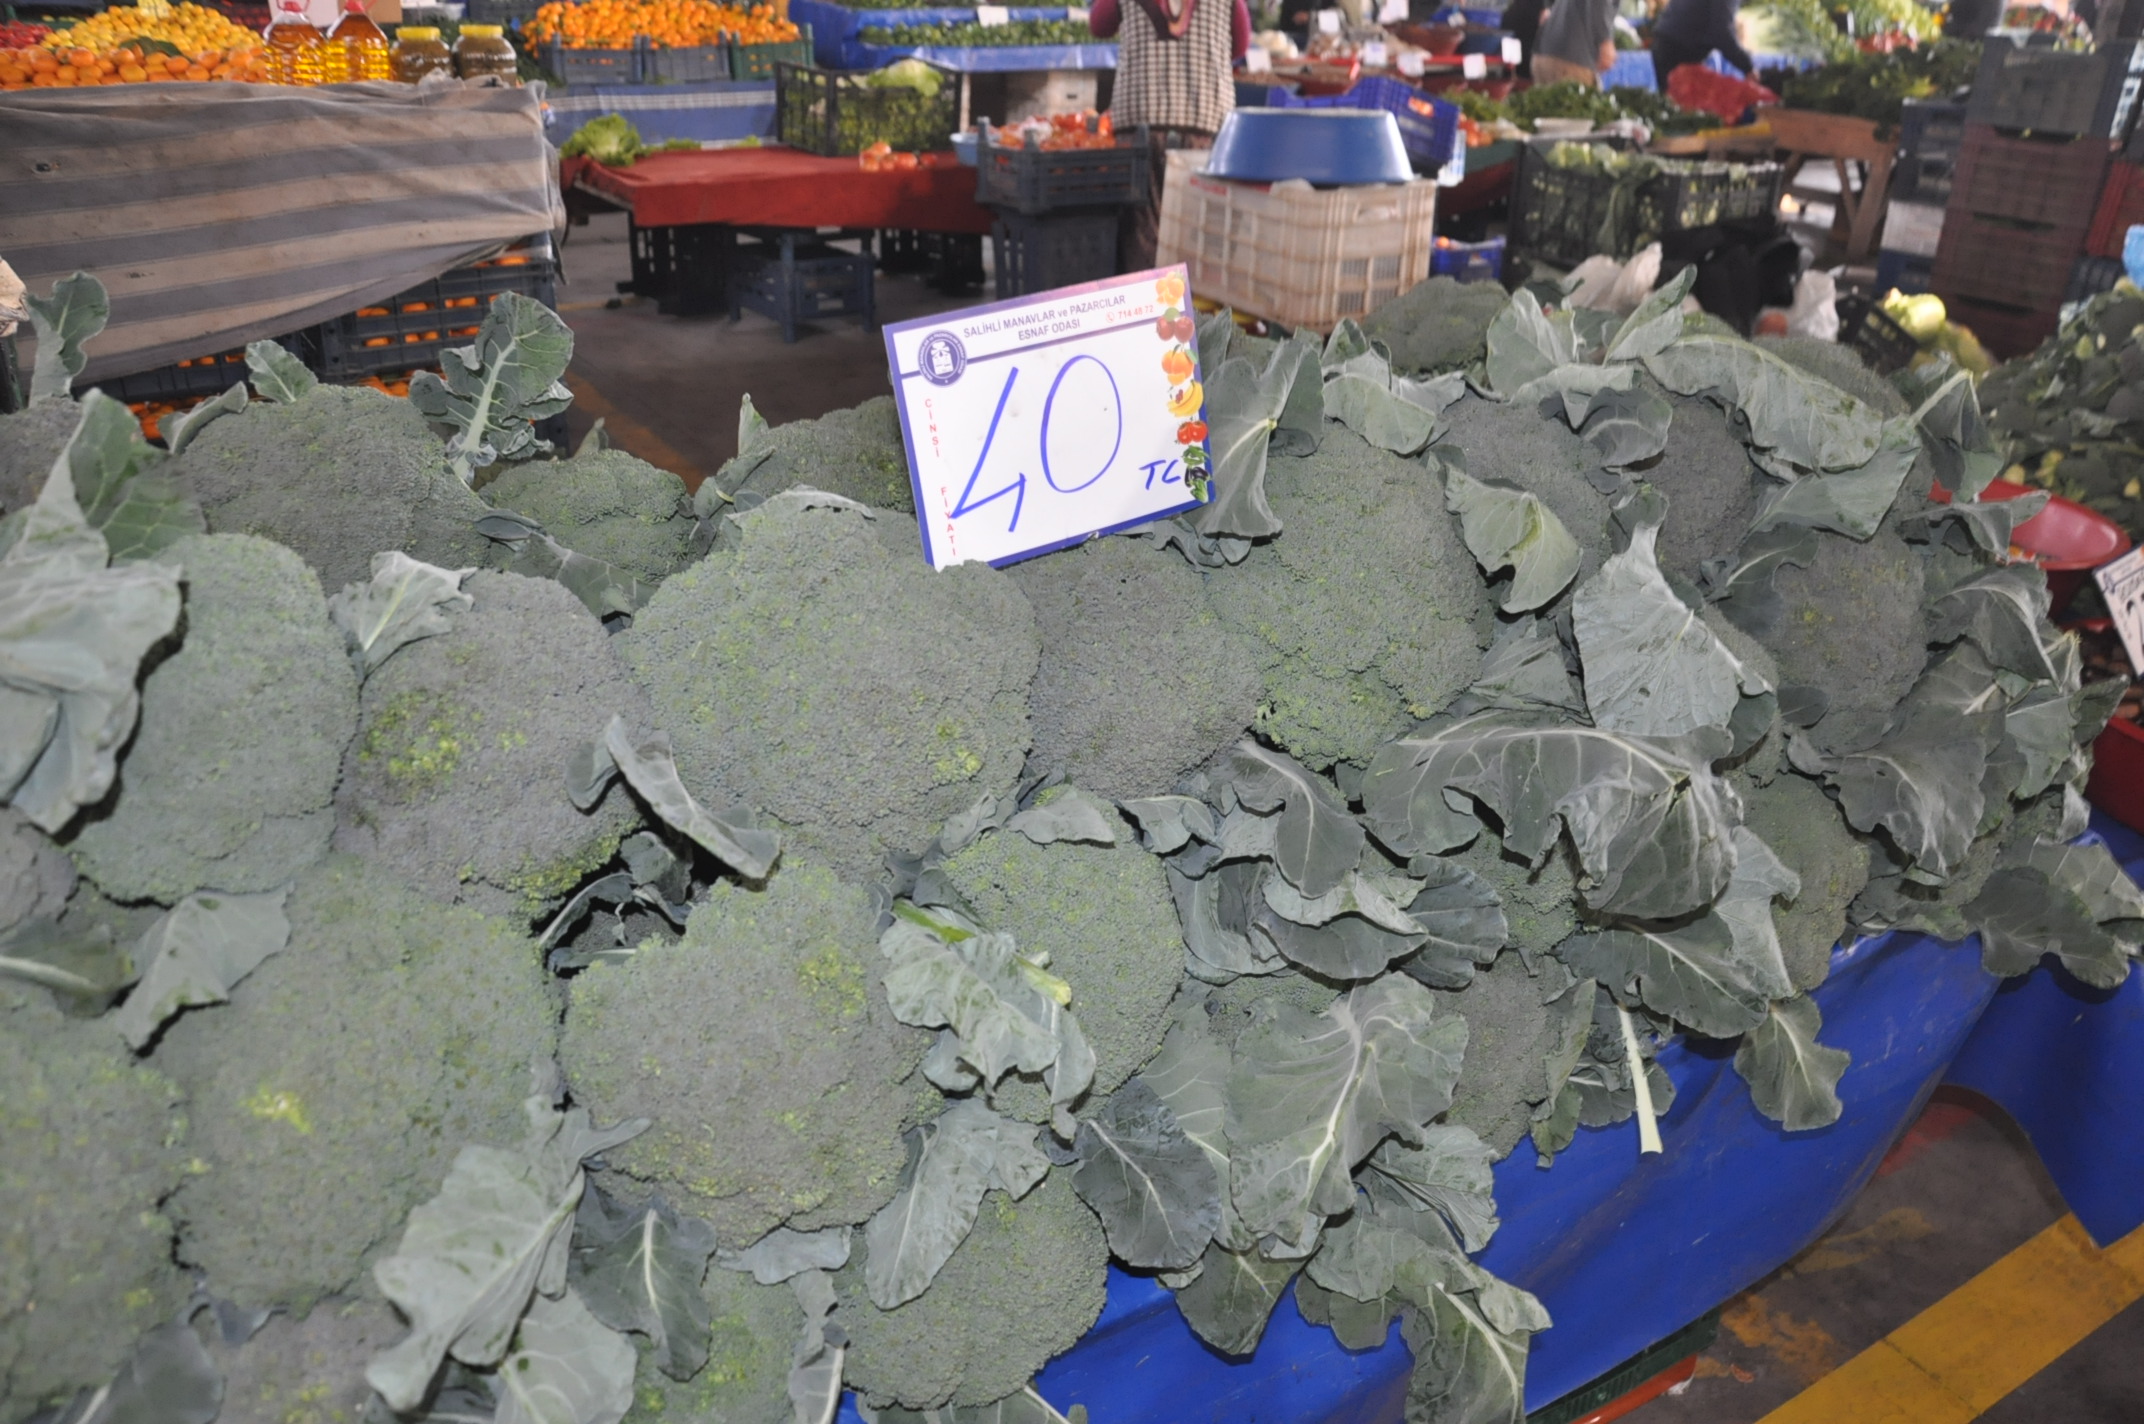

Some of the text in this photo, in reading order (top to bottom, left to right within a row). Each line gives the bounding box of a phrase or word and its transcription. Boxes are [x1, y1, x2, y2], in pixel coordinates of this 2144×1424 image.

[963, 295, 1126, 338] SALİHLİ MANAVLAR ve PAZARCILAR
[1118, 310, 1132, 320] 714
[1144, 304, 1154, 315] 72
[1018, 318, 1081, 341] ESNAF ODASI
[949, 354, 1122, 533] 40
